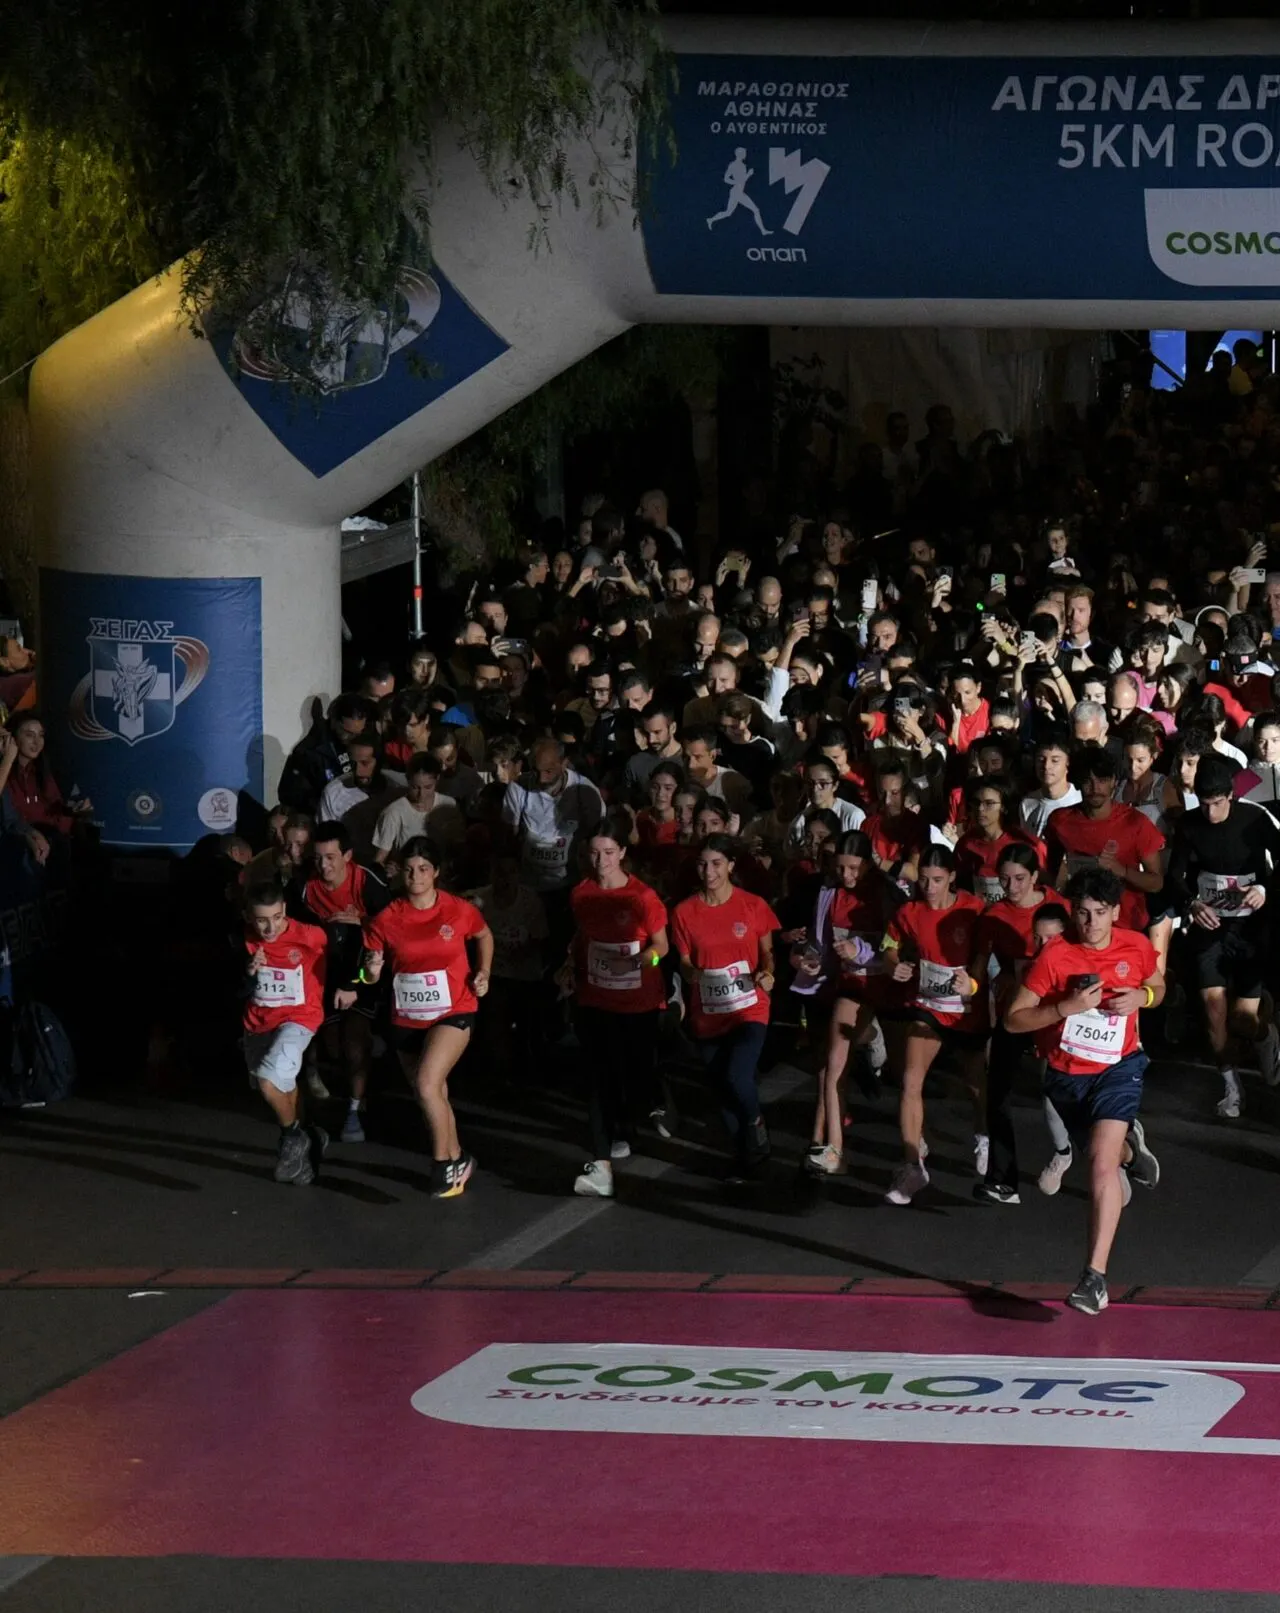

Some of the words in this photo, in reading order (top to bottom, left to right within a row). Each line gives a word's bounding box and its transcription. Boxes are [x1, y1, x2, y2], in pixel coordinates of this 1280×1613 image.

[697, 81, 850, 99] ΜΑΡΑΘΩΝΙΟΣ
[992, 75, 1205, 111] ΑΓΩΝΑΣ
[724, 101, 819, 118] ΑΘΗΝΑΣ
[710, 121, 722, 134] Ο
[726, 121, 828, 135] ΑΥΘΕΝΤΙΚΟΣ
[1058, 122, 1176, 169] 5KM
[89, 617, 174, 641] ΣΕΓΑΣ
[402, 990, 441, 1002] 75029
[706, 980, 745, 997] 75079
[1074, 1024, 1116, 1043] 75047
[506, 1362, 1170, 1404] COSMOTE
[486, 1388, 760, 1407] Συνδέουμε
[770, 1397, 855, 1409] τον
[863, 1400, 1020, 1416] κόσμο
[1030, 1406, 1134, 1418] σου.
